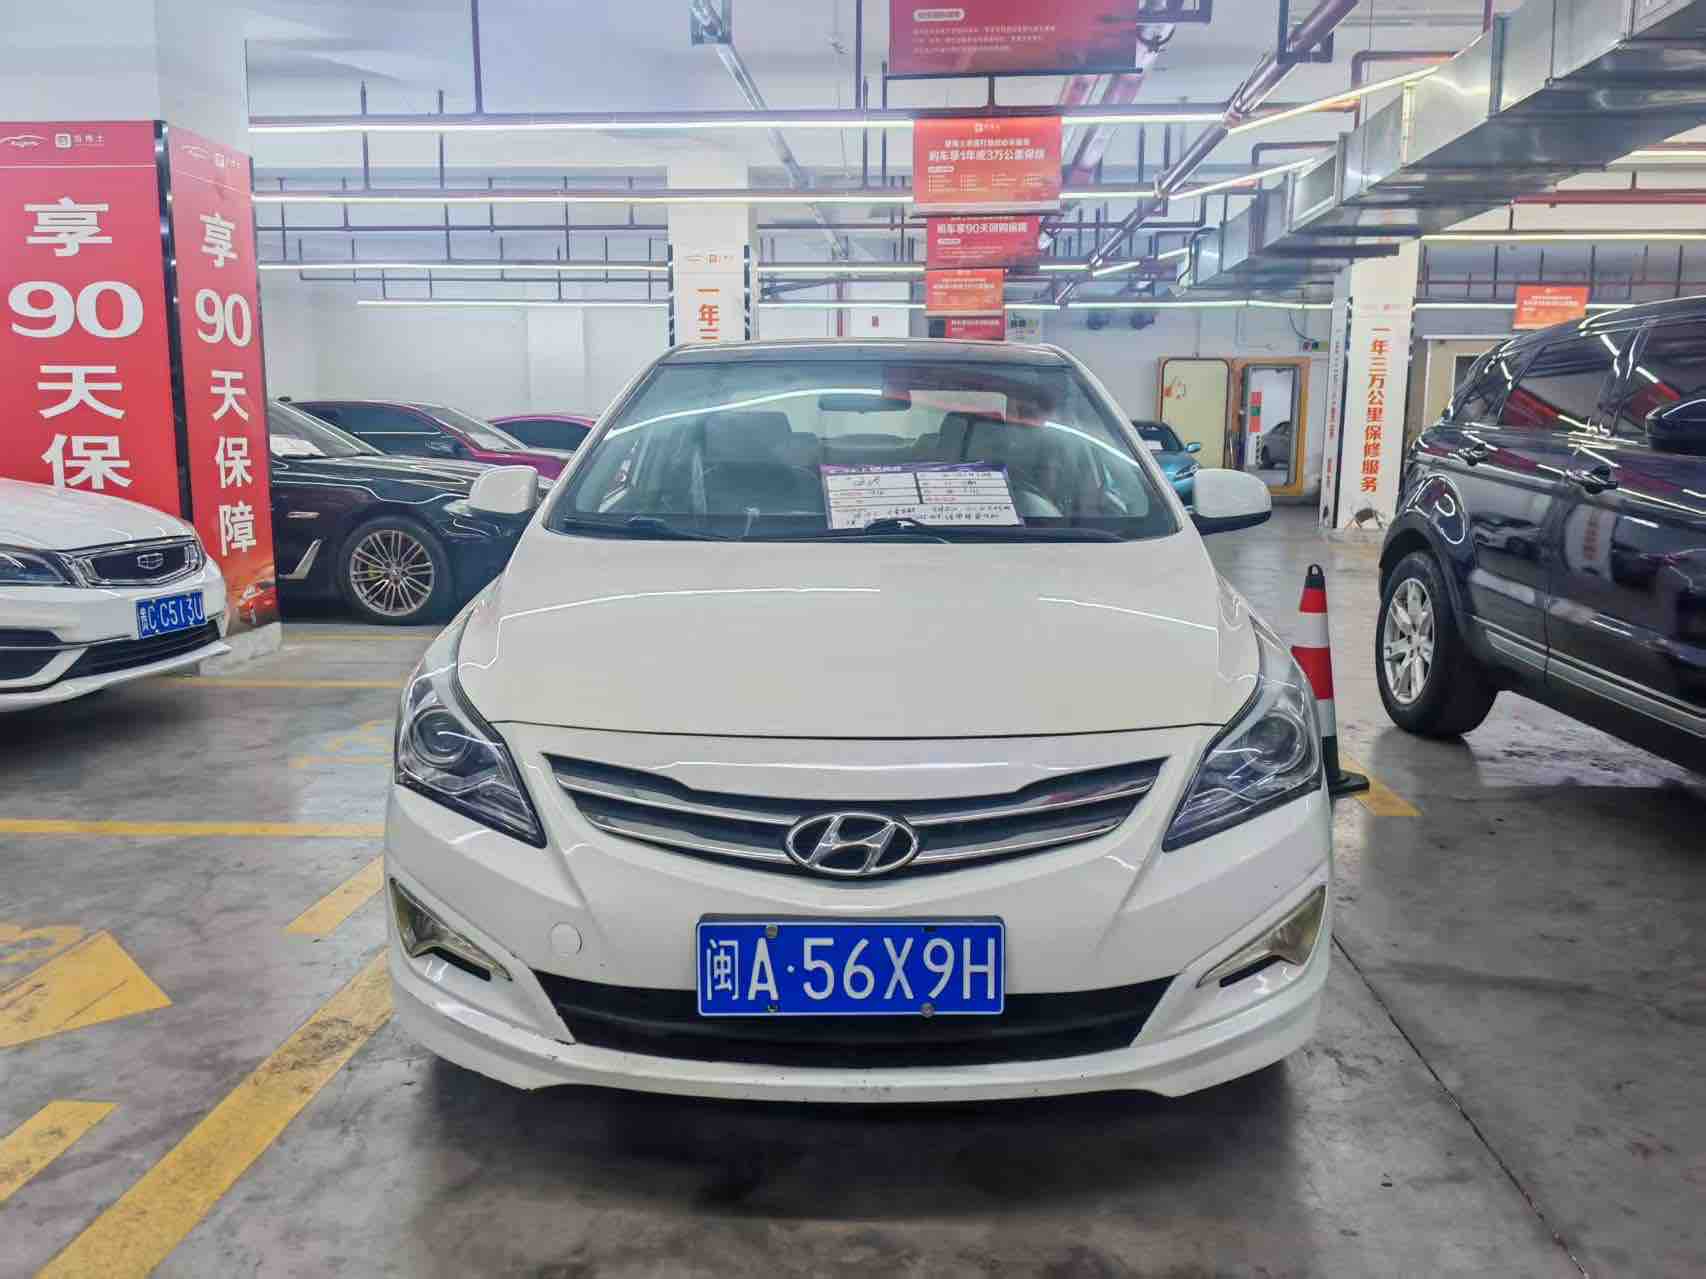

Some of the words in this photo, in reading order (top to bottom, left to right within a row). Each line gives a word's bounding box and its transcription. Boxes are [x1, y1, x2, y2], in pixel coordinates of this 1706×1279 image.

[195, 212, 257, 557] 享90天保障
[1359, 326, 1392, 493] 一年三万公里保修服务
